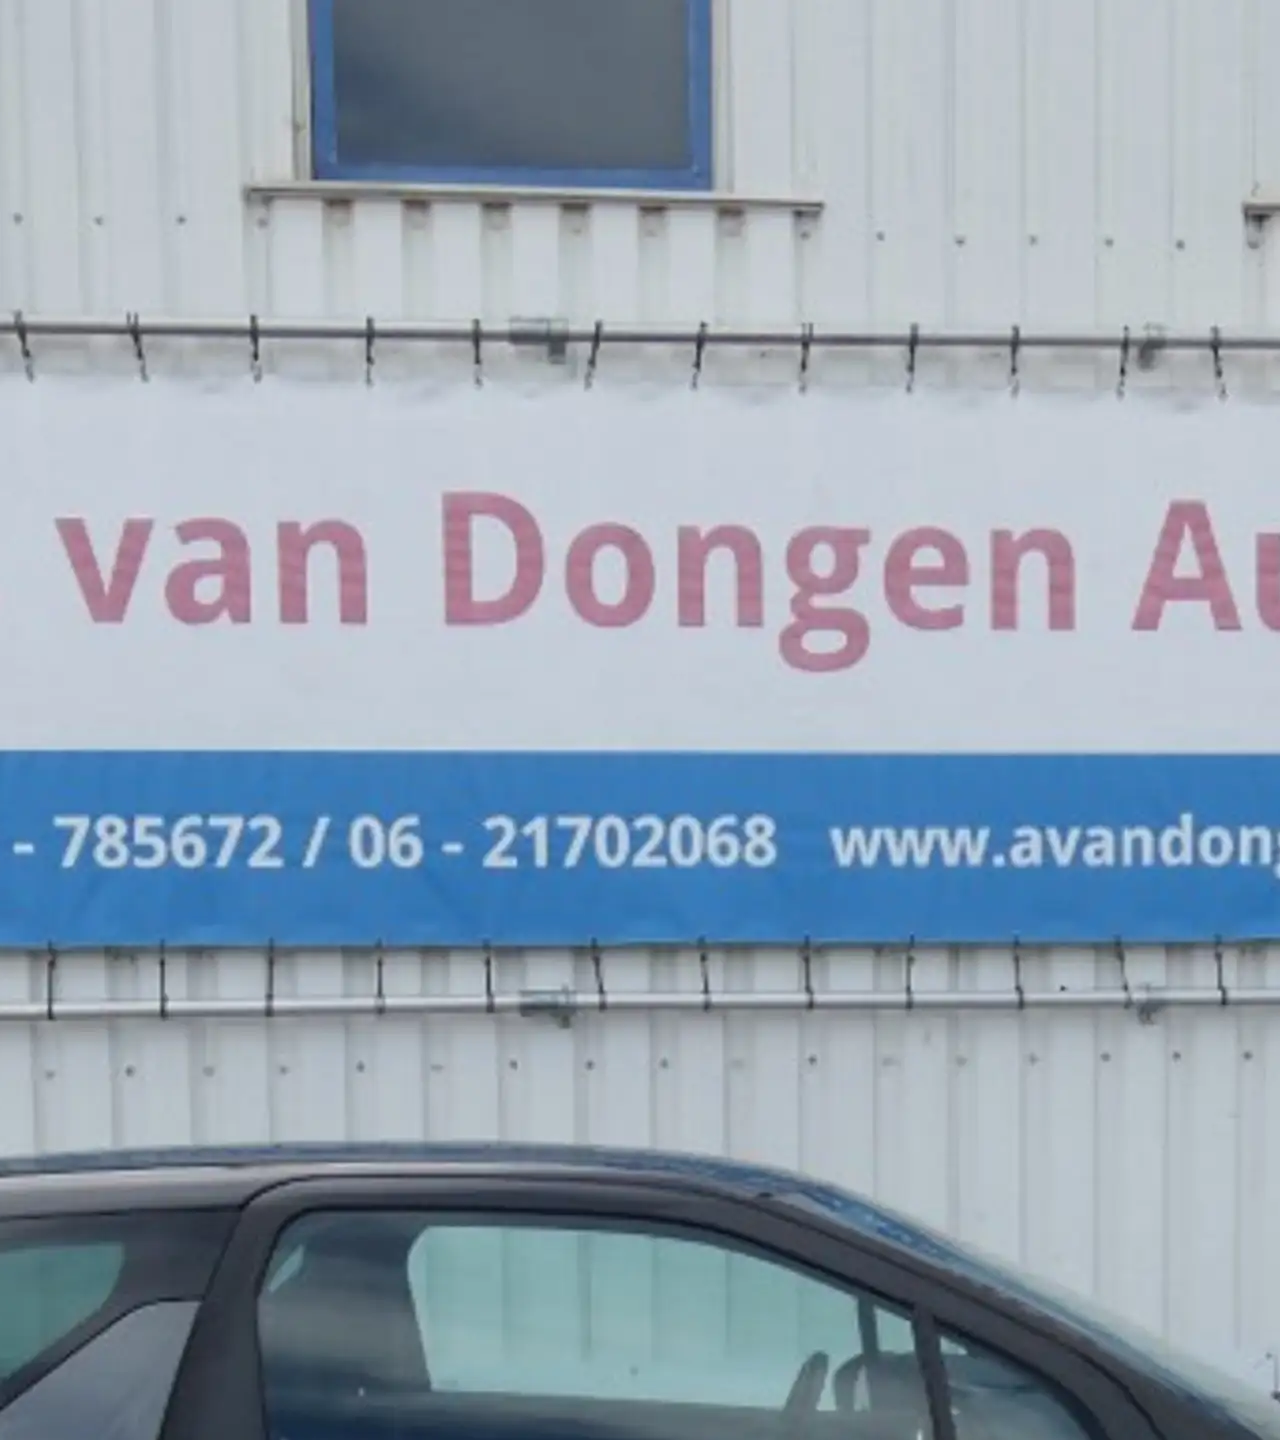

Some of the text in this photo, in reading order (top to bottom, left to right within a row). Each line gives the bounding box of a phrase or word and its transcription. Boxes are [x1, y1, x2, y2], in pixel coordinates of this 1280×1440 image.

[55, 516, 369, 626] van
[441, 490, 1077, 673] Dongen
[53, 814, 284, 870] 785672
[303, 815, 331, 869] /
[347, 814, 424, 870] 06
[482, 813, 778, 869] 21702068
